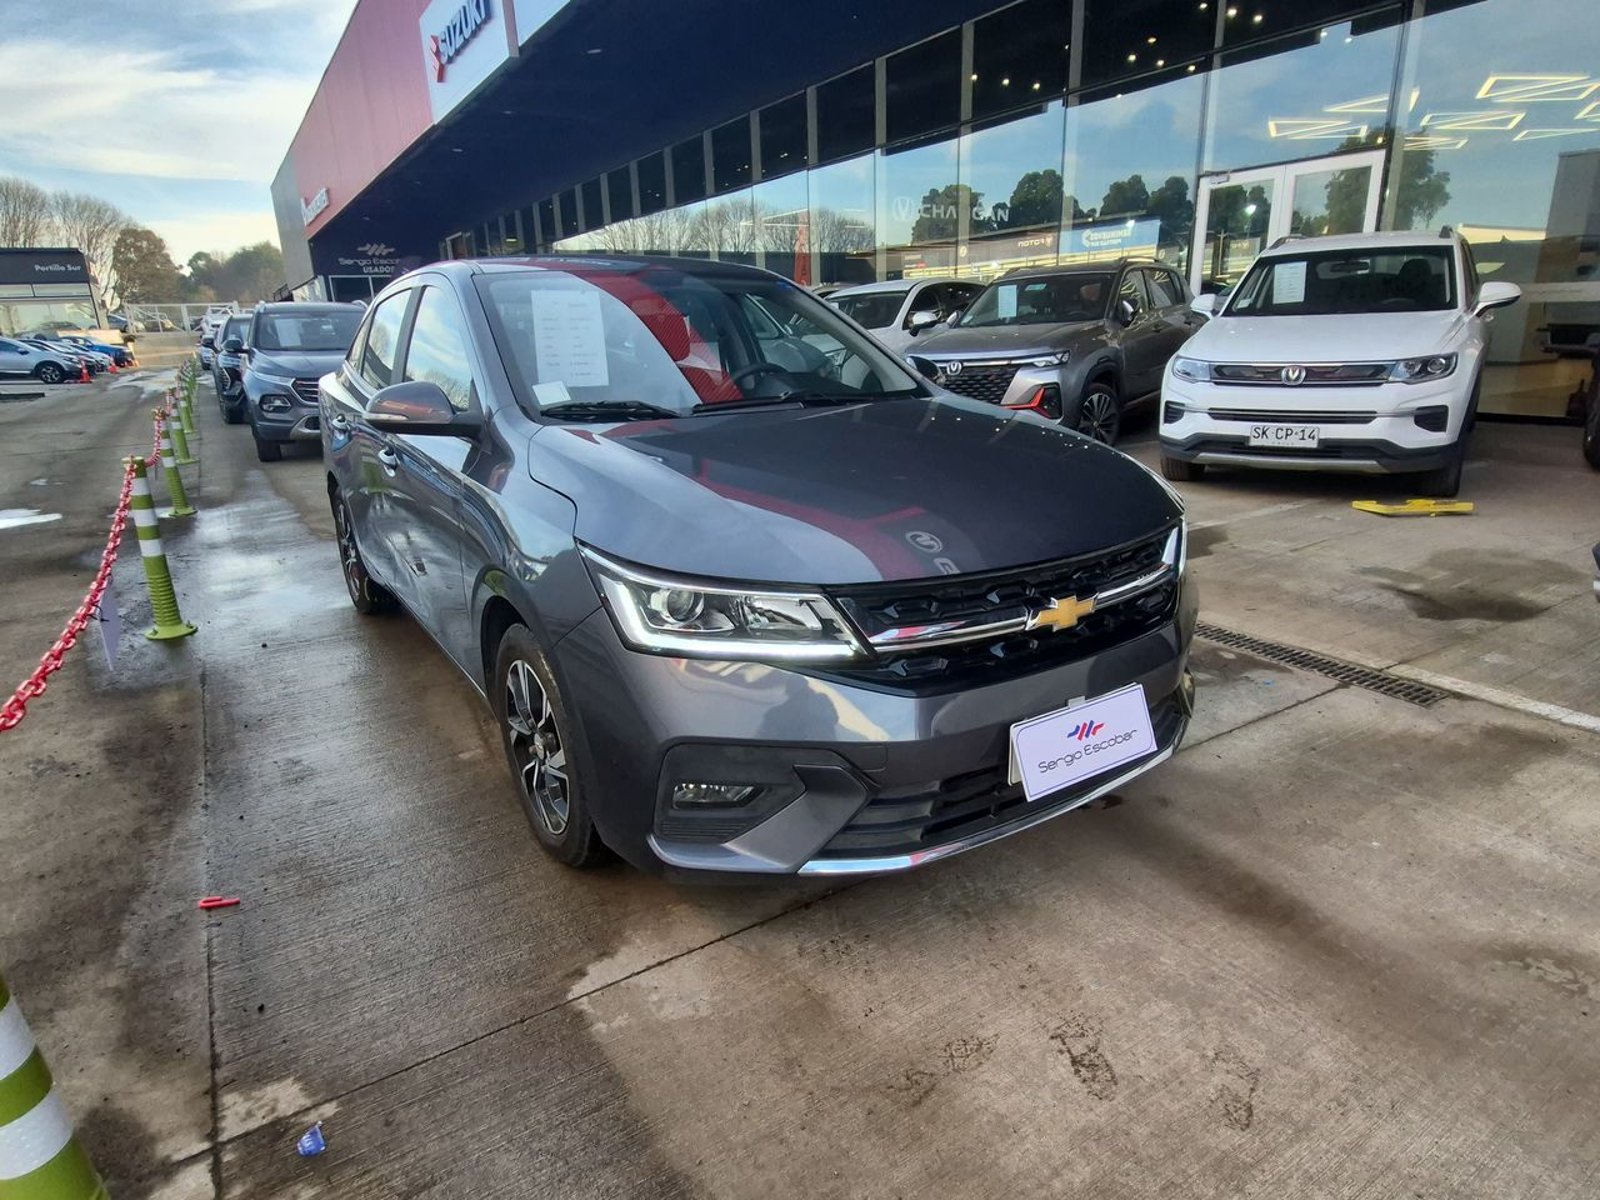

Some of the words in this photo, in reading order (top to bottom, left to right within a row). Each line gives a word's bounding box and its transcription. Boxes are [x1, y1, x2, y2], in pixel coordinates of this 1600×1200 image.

[440, 0, 491, 65] SUZUKI
[920, 203, 1010, 222] CHAGAN
[1083, 729, 1137, 756] Escobar
